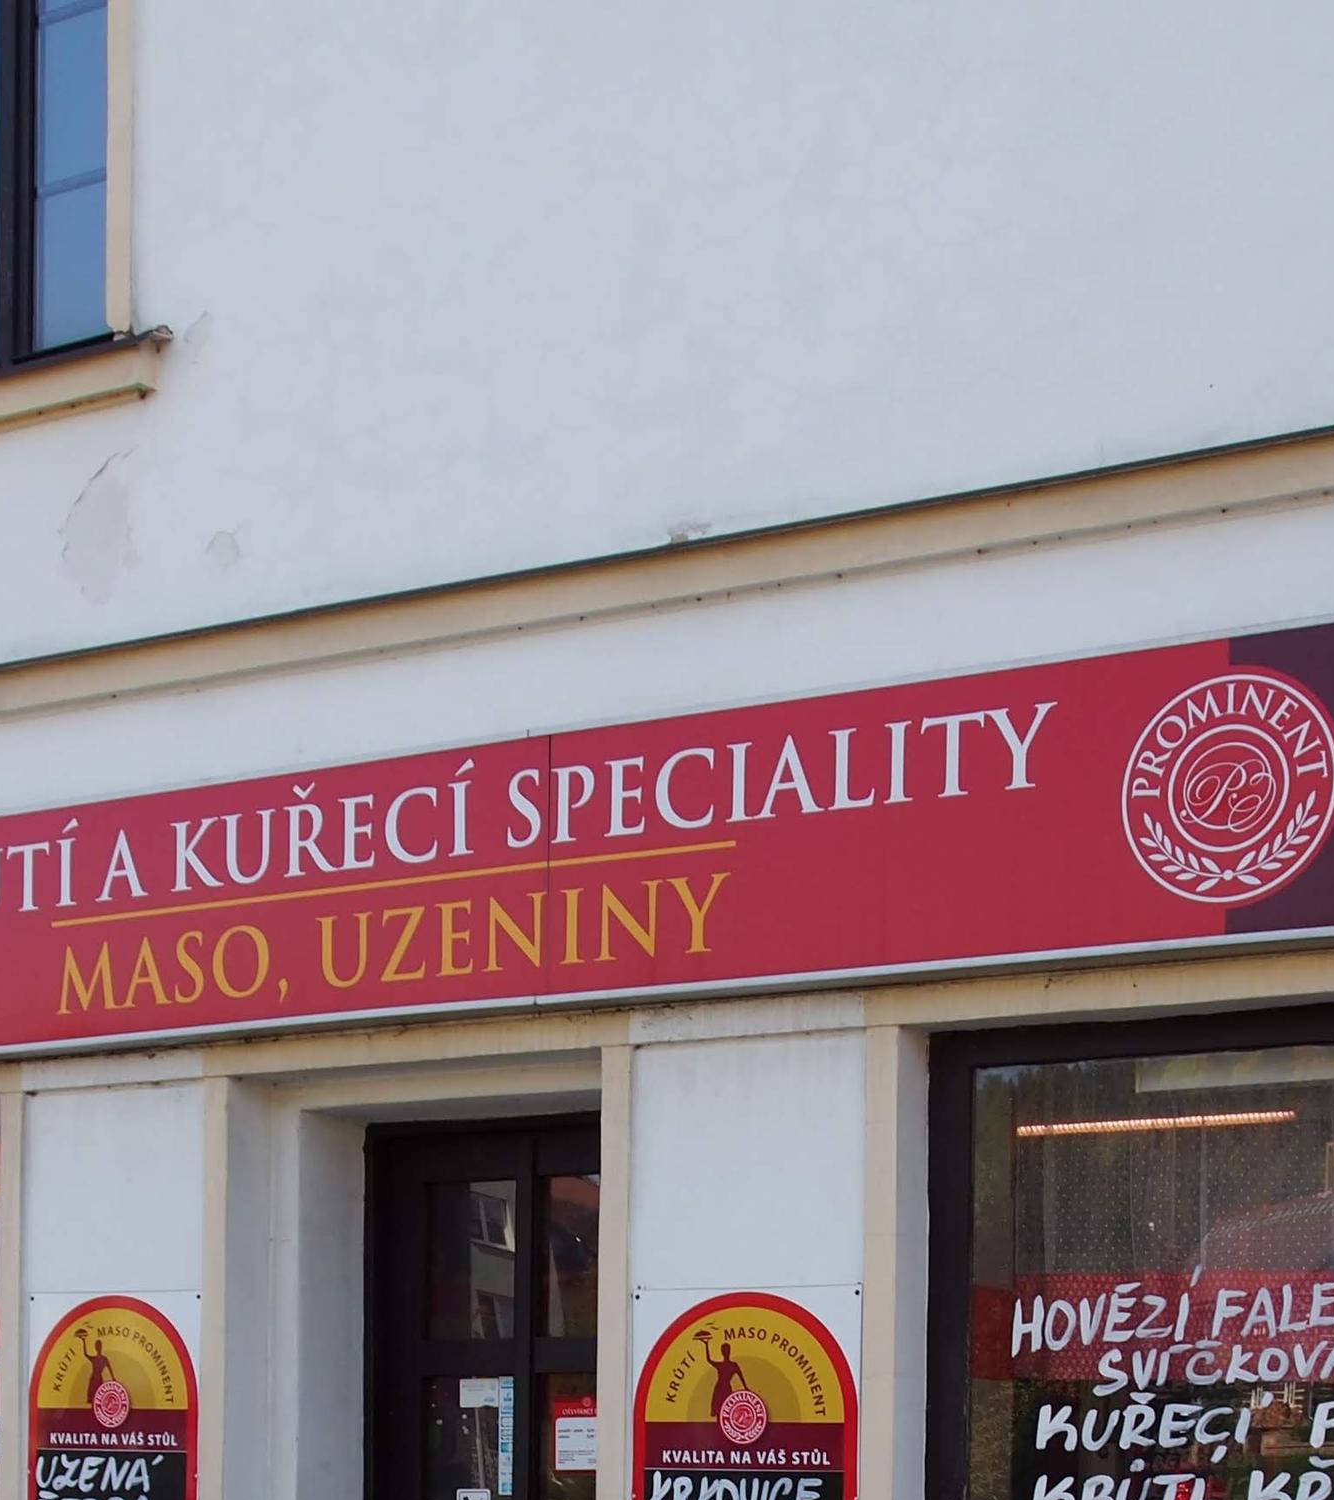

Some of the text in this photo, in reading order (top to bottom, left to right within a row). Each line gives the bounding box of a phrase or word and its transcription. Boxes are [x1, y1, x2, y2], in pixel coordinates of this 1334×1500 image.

[1131, 683, 1328, 799] PROMINENT
[95, 829, 149, 902] A
[171, 758, 474, 892] KUŘECÍ
[507, 701, 1058, 849] SPECIALITY
[56, 872, 731, 1016] MASO, UZENINY
[97, 1325, 130, 1338] MASO
[132, 1333, 174, 1403] PROMINENT
[723, 1326, 767, 1341] MASO
[771, 1333, 827, 1417] PROMINENT
[50, 1432, 177, 1446] KVALITA NA VÁŠ STŮL
[662, 1448, 830, 1465] KVALITA NA VÁŠ STŮL
